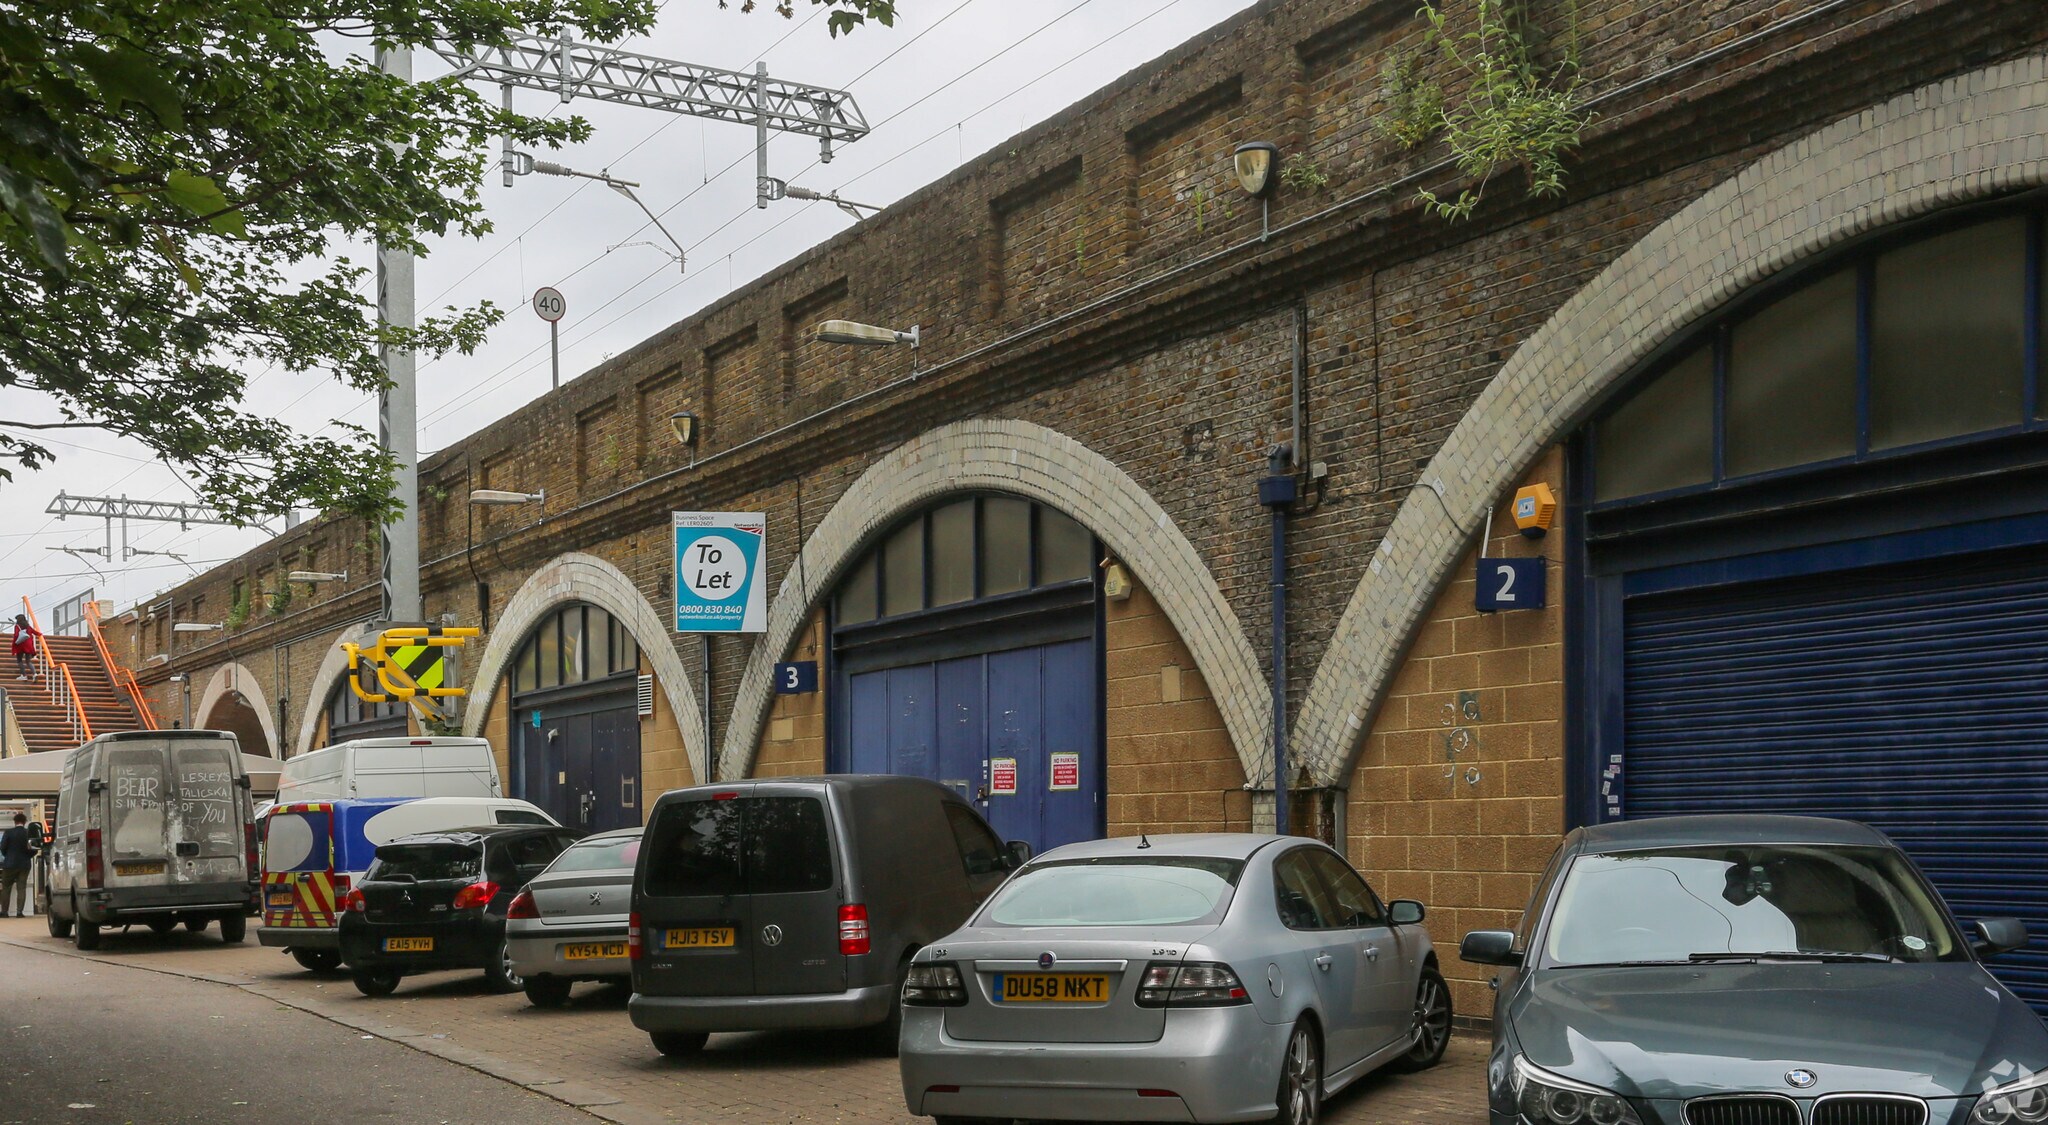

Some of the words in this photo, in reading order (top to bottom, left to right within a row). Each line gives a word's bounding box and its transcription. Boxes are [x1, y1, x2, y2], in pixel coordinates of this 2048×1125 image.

[539, 297, 561, 313] 40
[1517, 501, 1535, 515] ADT
[697, 544, 722, 564] To
[696, 570, 732, 589] Let
[1496, 566, 1516, 602] 2
[680, 605, 703, 613] 0800
[705, 605, 723, 613] 830
[724, 605, 742, 613] 840
[786, 667, 799, 688] 3
[182, 772, 231, 783] LESLEY'S
[117, 777, 159, 798] BEAR
[127, 799, 136, 808] IN
[182, 802, 194, 813] OF
[390, 938, 410, 949] EA15
[412, 938, 430, 949] YVH
[670, 931, 699, 944] HJ13
[702, 930, 728, 944] TSV
[569, 946, 597, 957] KY54
[601, 944, 624, 956] WCD
[1006, 977, 1058, 998] DU58
[1064, 977, 1104, 998] NKT
